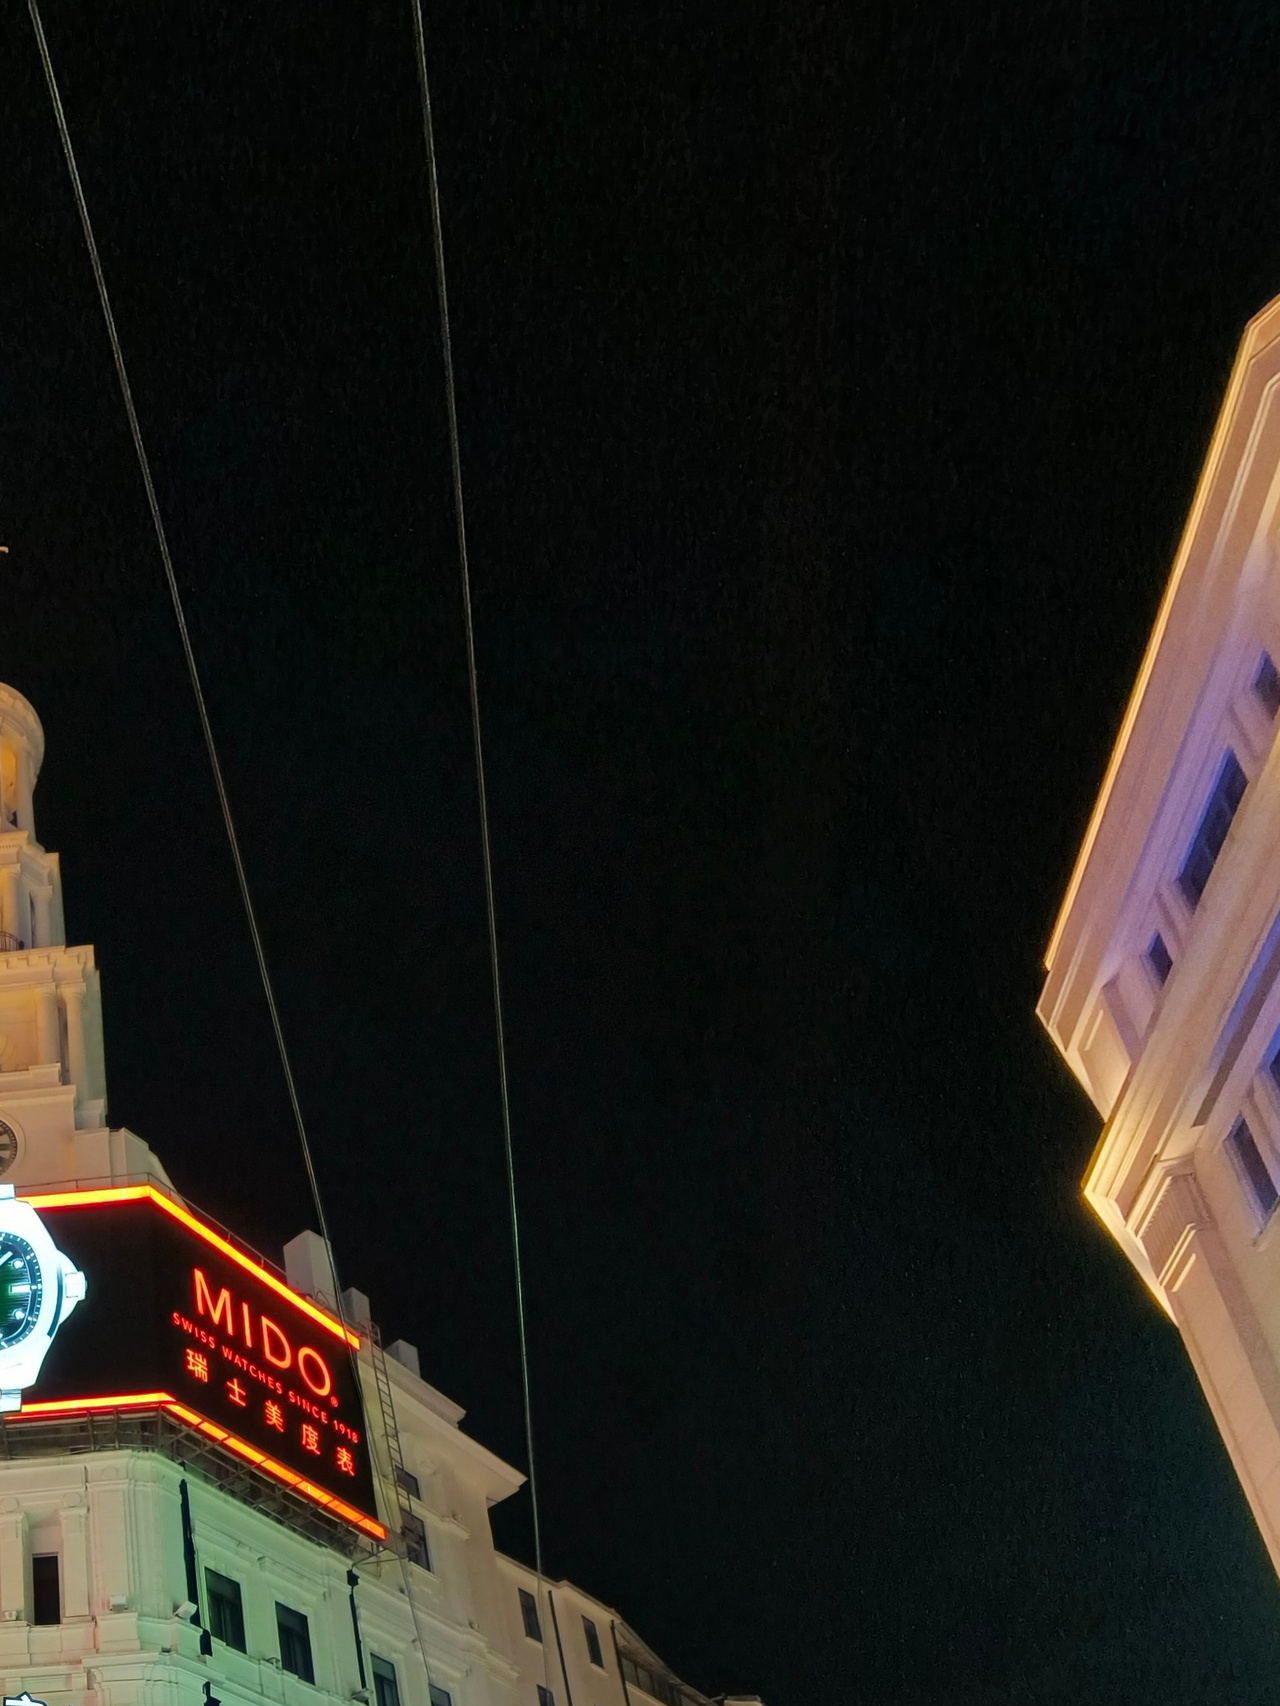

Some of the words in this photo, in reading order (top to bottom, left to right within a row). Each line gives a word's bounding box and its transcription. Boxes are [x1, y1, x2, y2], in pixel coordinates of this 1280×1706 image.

[173, 1312, 216, 1349] SWISS
[222, 1345, 283, 1394] WATCHES
[288, 1391, 328, 1424] SINCE
[333, 1420, 358, 1444] 1918
[194, 1268, 331, 1396] MIDO
[186, 1349, 355, 1476] 瑞士美度表
